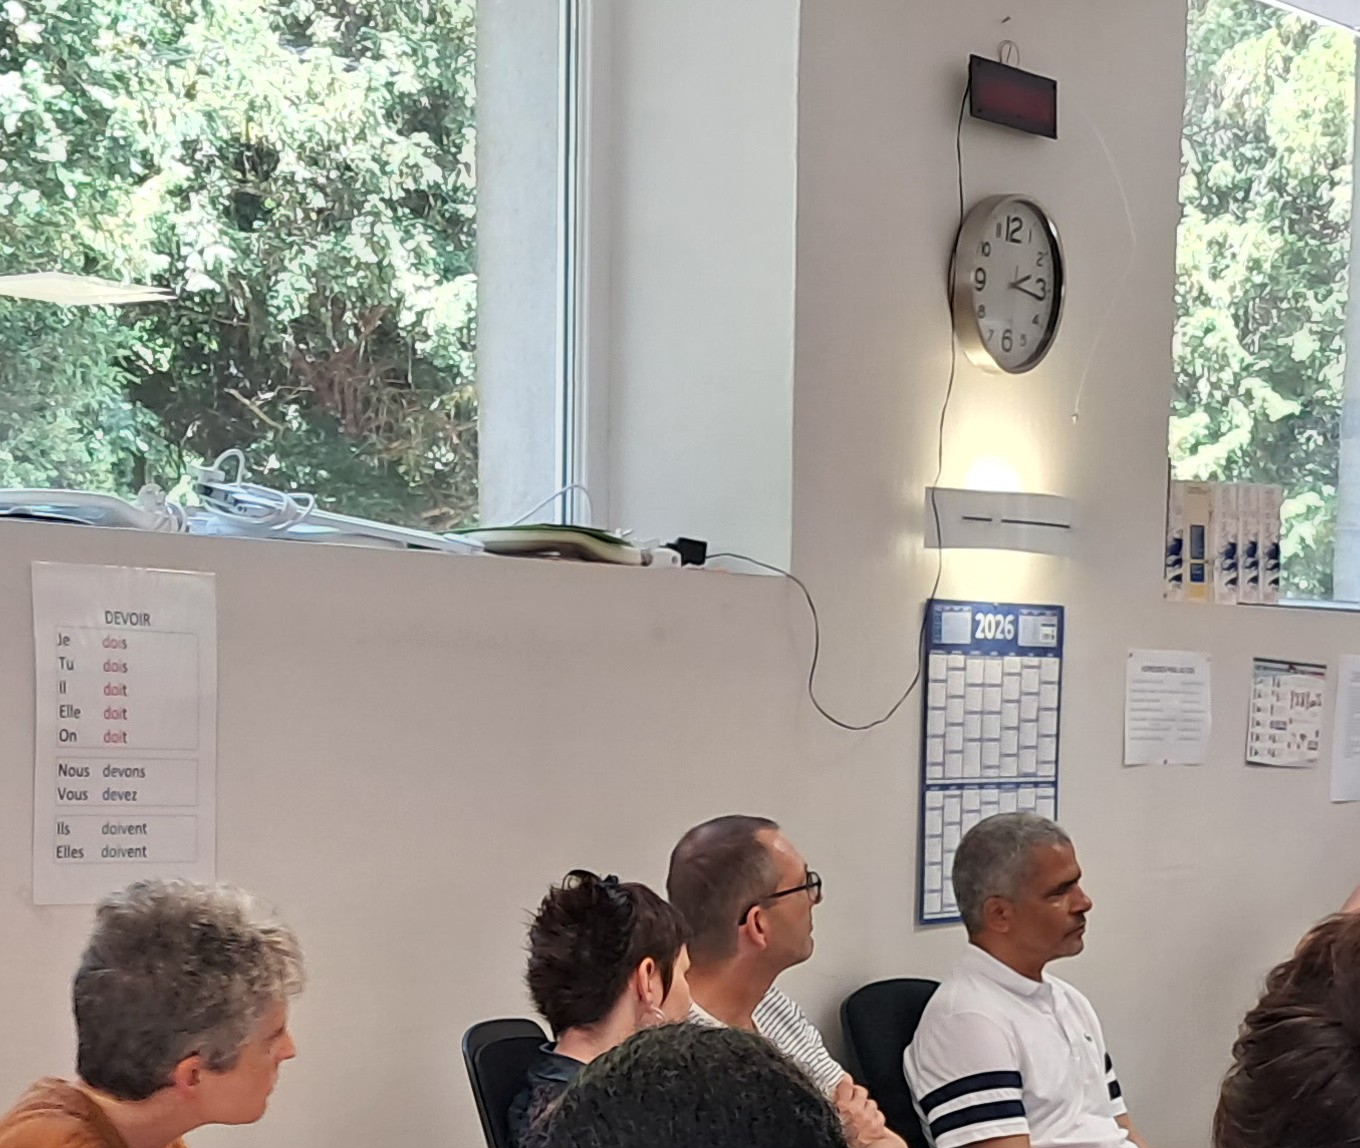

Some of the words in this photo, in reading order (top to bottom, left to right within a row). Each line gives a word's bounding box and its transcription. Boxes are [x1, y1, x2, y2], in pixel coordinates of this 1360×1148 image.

[1005, 215, 1023, 244] 12
[974, 267, 987, 292] 9
[1001, 328, 1013, 352] 6
[104, 610, 151, 627] DEVOIR
[975, 613, 1015, 641] 2026
[57, 632, 71, 647] Je
[102, 635, 128, 650] dois
[58, 656, 75, 671] Tu
[102, 659, 129, 674] dois
[103, 682, 128, 697] doit
[59, 704, 82, 720] Elle
[103, 706, 128, 721] doit
[58, 728, 78, 743] On
[103, 729, 128, 744] doit
[57, 763, 91, 778] Nous
[102, 763, 146, 779] devons
[57, 787, 89, 801] Vous
[102, 787, 138, 802] devez
[101, 822, 148, 836] doivent
[55, 844, 85, 859] Elles
[100, 844, 148, 859] doivent
